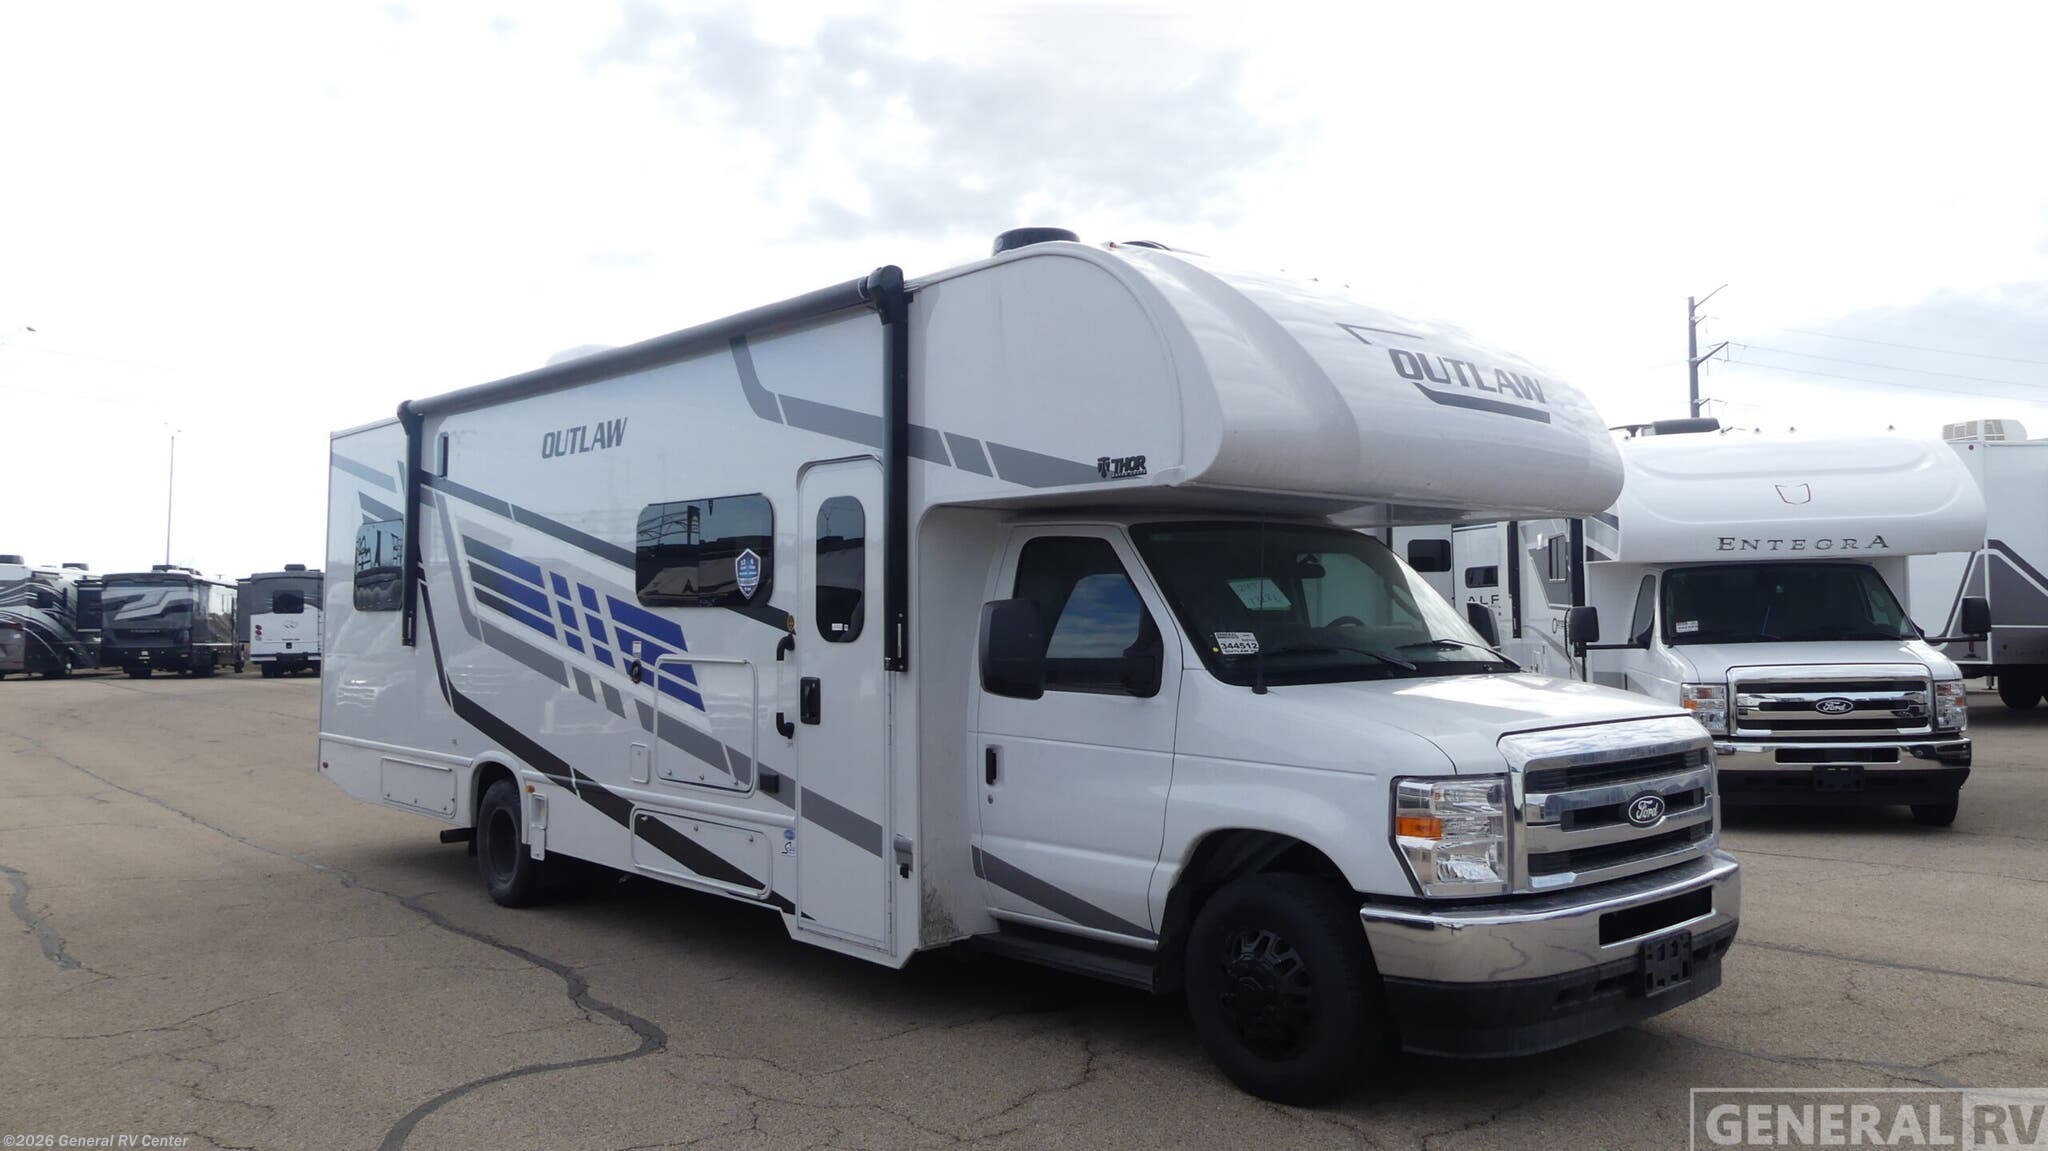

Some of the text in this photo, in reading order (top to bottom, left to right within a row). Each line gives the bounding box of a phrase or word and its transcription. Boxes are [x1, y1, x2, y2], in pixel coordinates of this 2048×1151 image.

[1388, 348, 1546, 404] OUTLAW
[541, 416, 628, 459] OUTLAW
[1111, 455, 1146, 474] THOR
[1716, 535, 1889, 551] ENTEGRA
[1220, 642, 1259, 650] 344512
[1822, 701, 1846, 711] Ford
[1636, 800, 1659, 819] Ford
